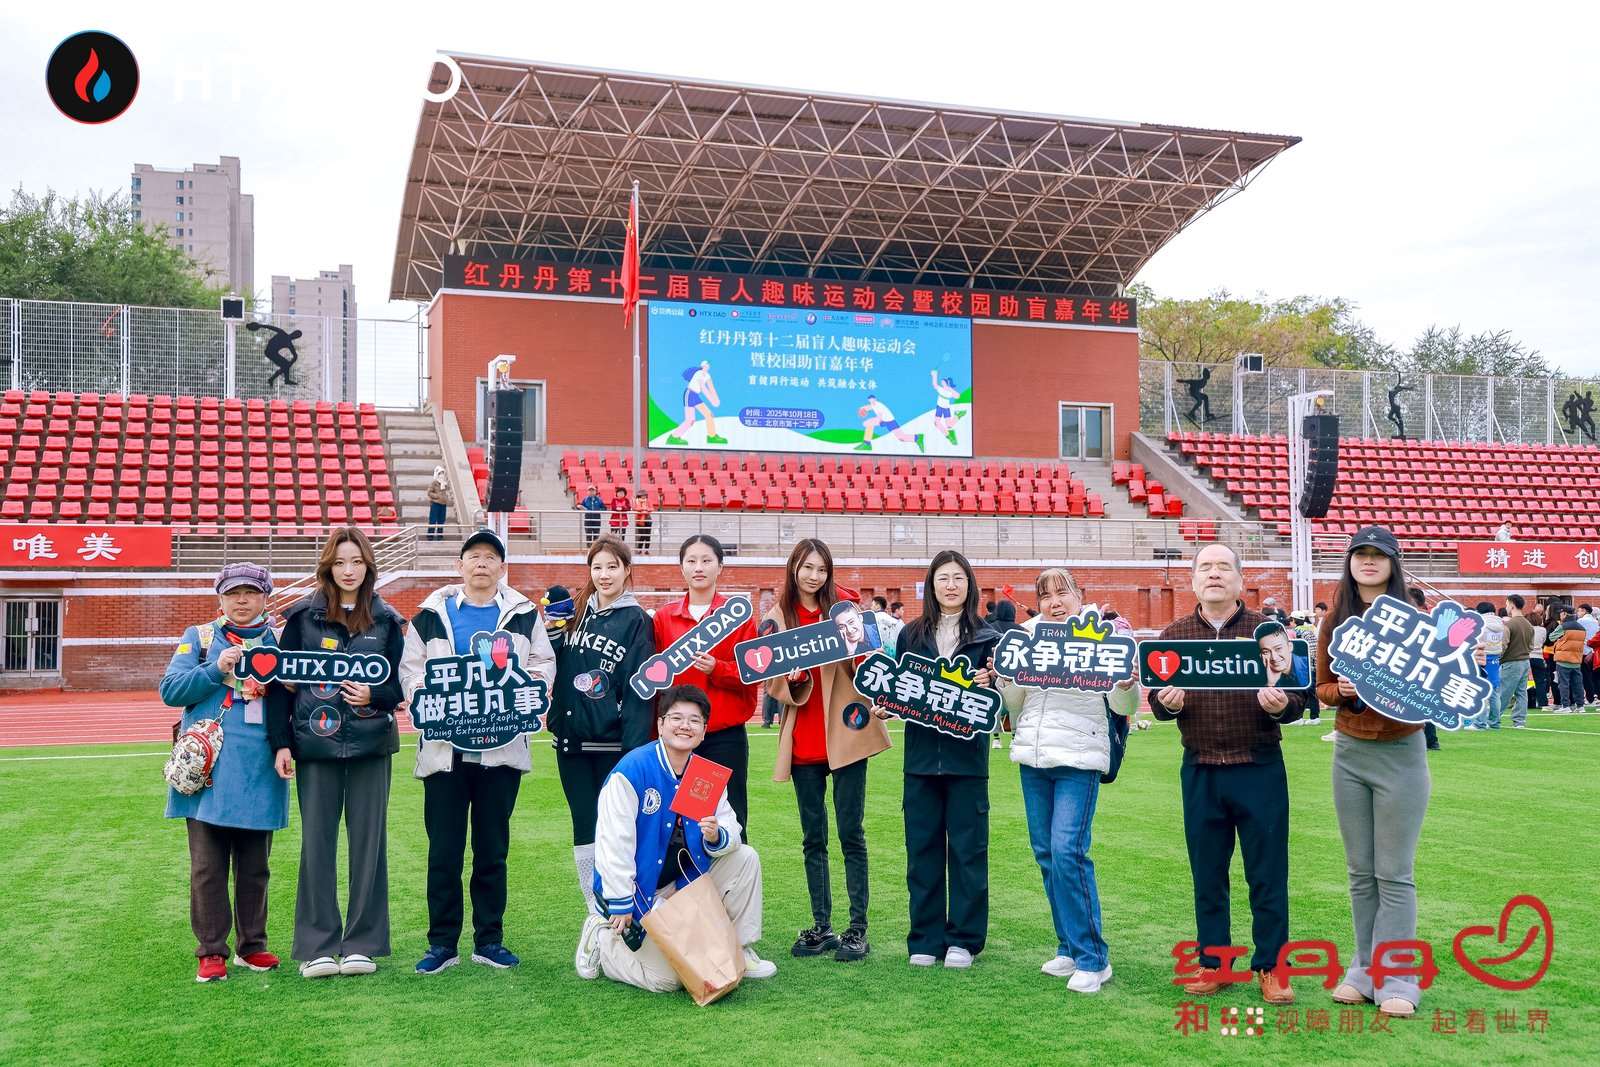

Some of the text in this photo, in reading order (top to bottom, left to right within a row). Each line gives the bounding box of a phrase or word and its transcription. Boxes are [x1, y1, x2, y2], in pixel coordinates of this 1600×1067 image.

[464, 261, 1129, 324] 红丹丹第十二届盲人趣味运动会暨校园助盲嘉年华
[700, 329, 916, 355] 红丹丹第十二届盲人趣味运动会
[751, 352, 873, 373] 暨校园助盲嘉年华
[13, 532, 122, 561] 唯美
[637, 602, 746, 692] I HTX DAO
[1041, 628, 1067, 638] TRON
[1372, 603, 1471, 674] 平凡人
[239, 656, 383, 678] I HTX DAO
[754, 634, 839, 669] I Justin
[1000, 638, 1129, 677] 永争冠军
[1158, 654, 1260, 675] I Justin
[1337, 624, 1483, 710] 做非凡事
[430, 658, 526, 691] 平凡人
[908, 660, 936, 676] TRON
[1017, 671, 1113, 689] Champion's Mindset
[1362, 661, 1441, 706] Ordinary People
[416, 686, 543, 723] 做非凡事
[862, 660, 993, 724] 永争冠军
[1336, 659, 1456, 726] Doing Extraordinary Job
[1374, 692, 1405, 714] TRON
[427, 720, 538, 738] Doing Extraordinary Job
[446, 711, 519, 726] Ordinary People
[876, 694, 973, 735] Champion's Mindset
[469, 735, 498, 744] TRON
